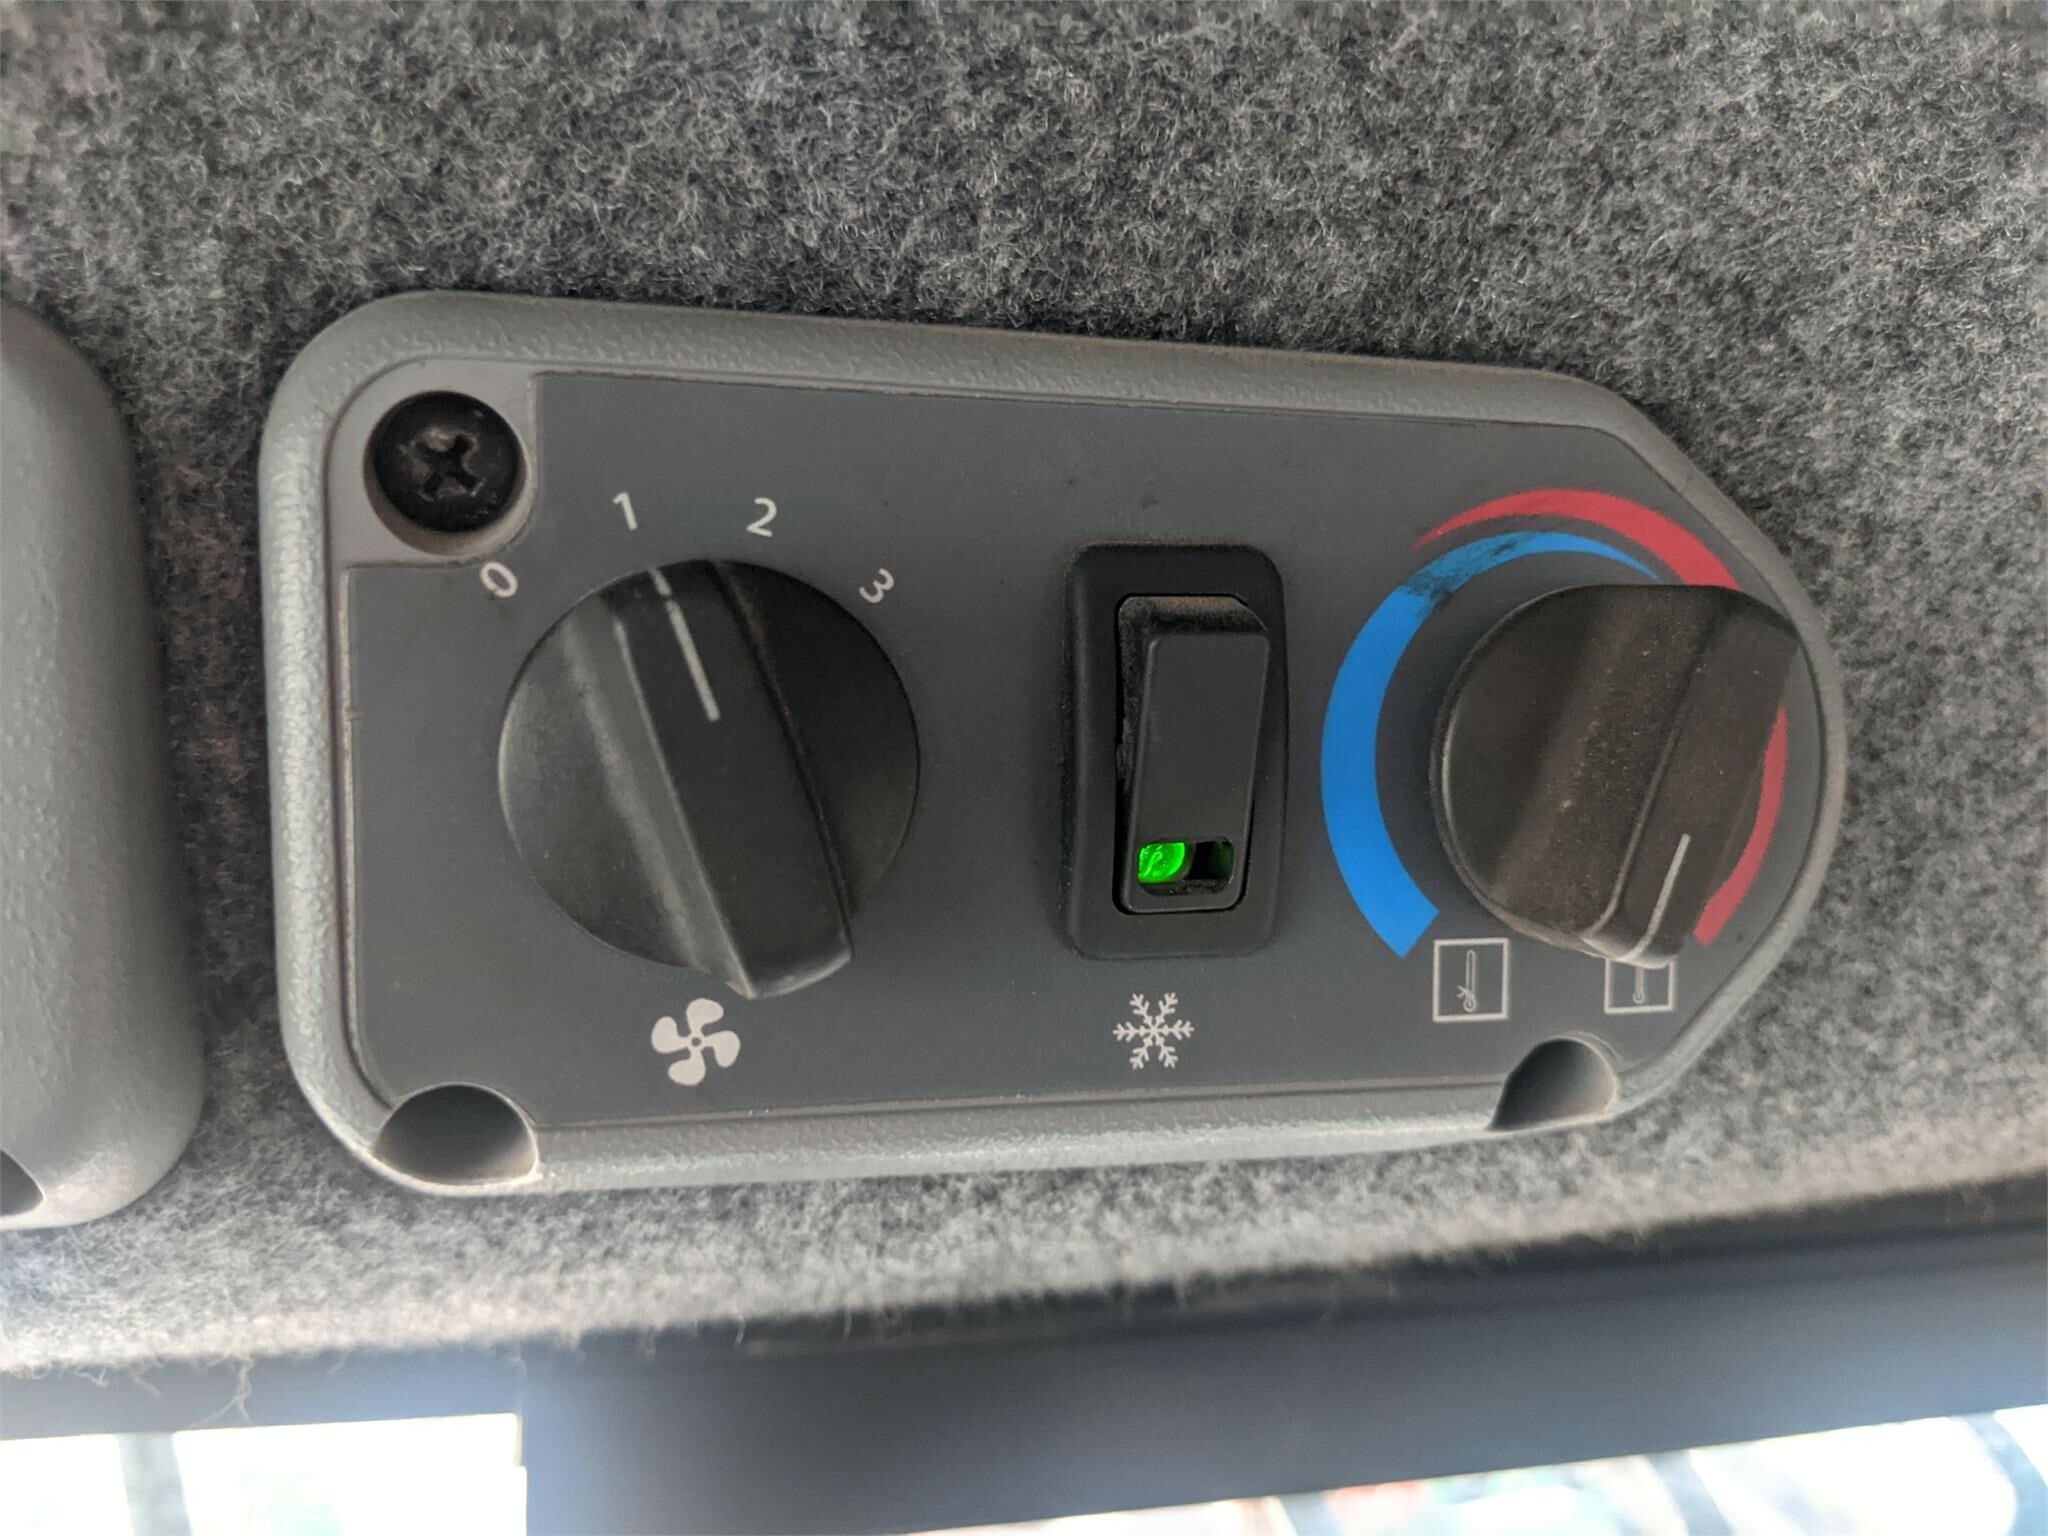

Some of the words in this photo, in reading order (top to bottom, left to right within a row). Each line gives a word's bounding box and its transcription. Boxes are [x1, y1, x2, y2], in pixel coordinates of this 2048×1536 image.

[612, 491, 638, 530] 1
[746, 496, 778, 538] 2
[479, 561, 519, 598] 0
[858, 567, 895, 604] 3
